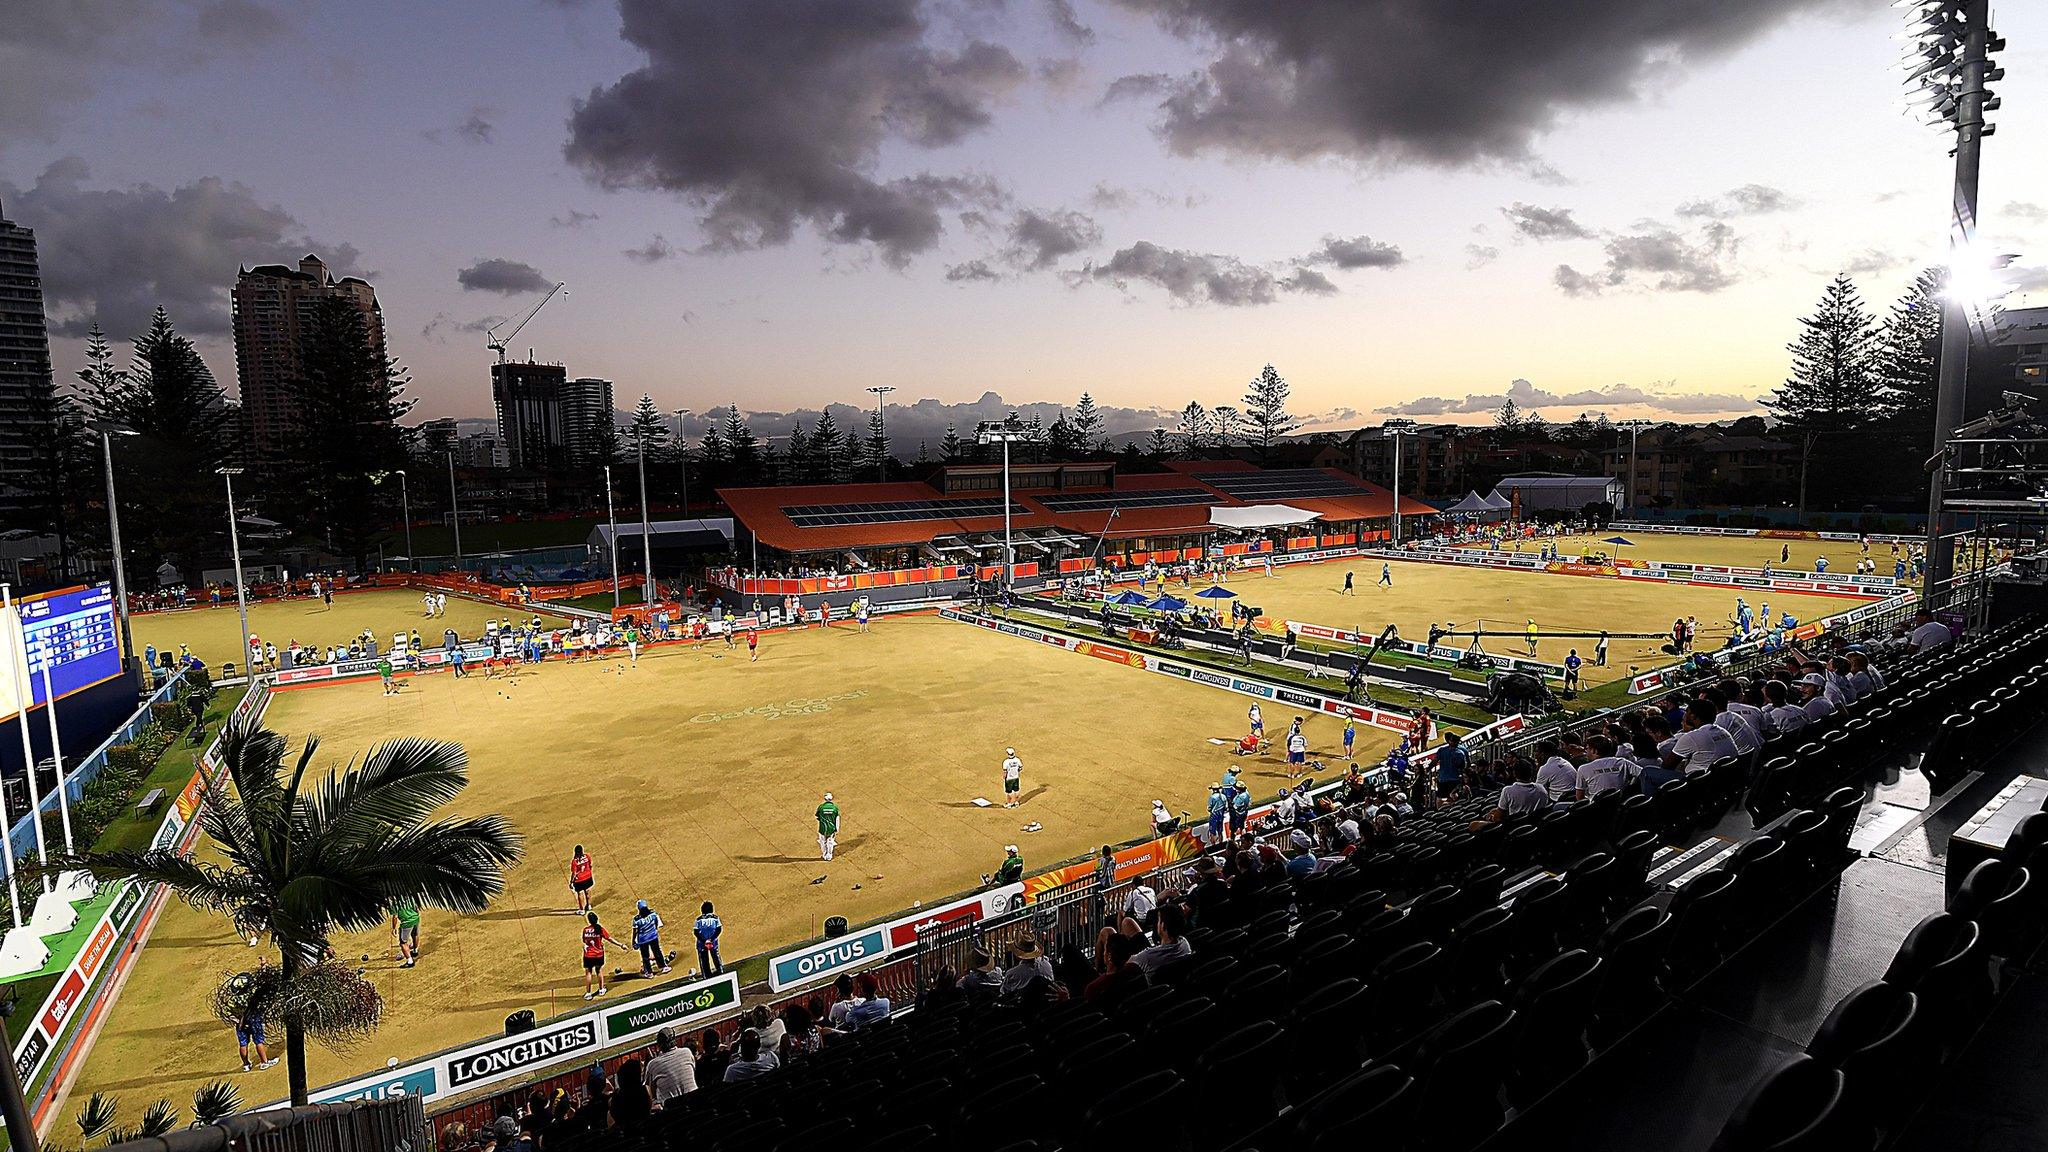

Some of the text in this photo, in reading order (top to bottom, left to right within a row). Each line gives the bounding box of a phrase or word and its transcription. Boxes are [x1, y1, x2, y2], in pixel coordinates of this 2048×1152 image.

[1194, 671, 1229, 686] LONGINES
[1239, 682, 1266, 695] OPTUS
[690, 688, 869, 723] Gold Coast
[1133, 853, 1151, 865] GAMES
[798, 940, 865, 975] OPTUS
[52, 998, 69, 1022] tafe
[629, 998, 694, 1027] Woolworths
[21, 1040, 39, 1068] STAR
[453, 1025, 591, 1083] LONGINES
